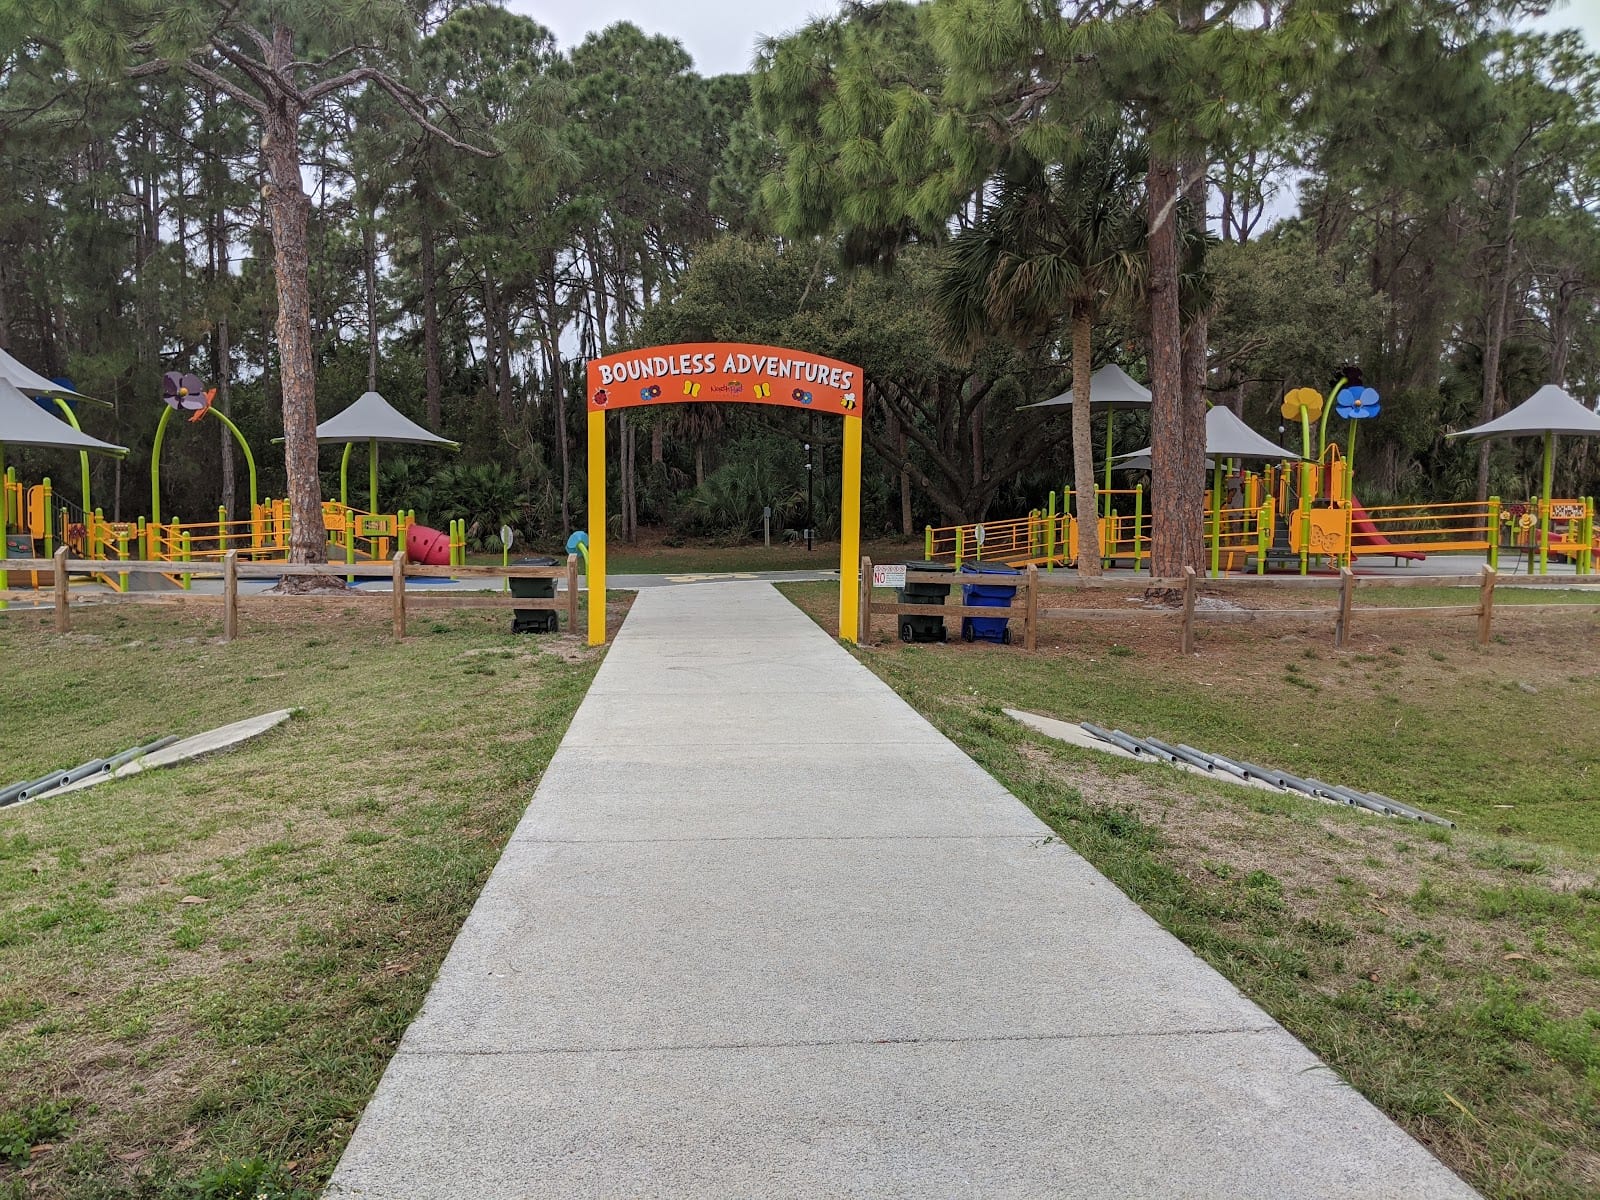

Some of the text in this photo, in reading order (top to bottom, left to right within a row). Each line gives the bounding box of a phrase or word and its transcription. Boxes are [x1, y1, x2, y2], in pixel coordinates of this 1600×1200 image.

[598, 352, 853, 390] BOUNDLESS ADVENTURES
[874, 572, 886, 584] NO
